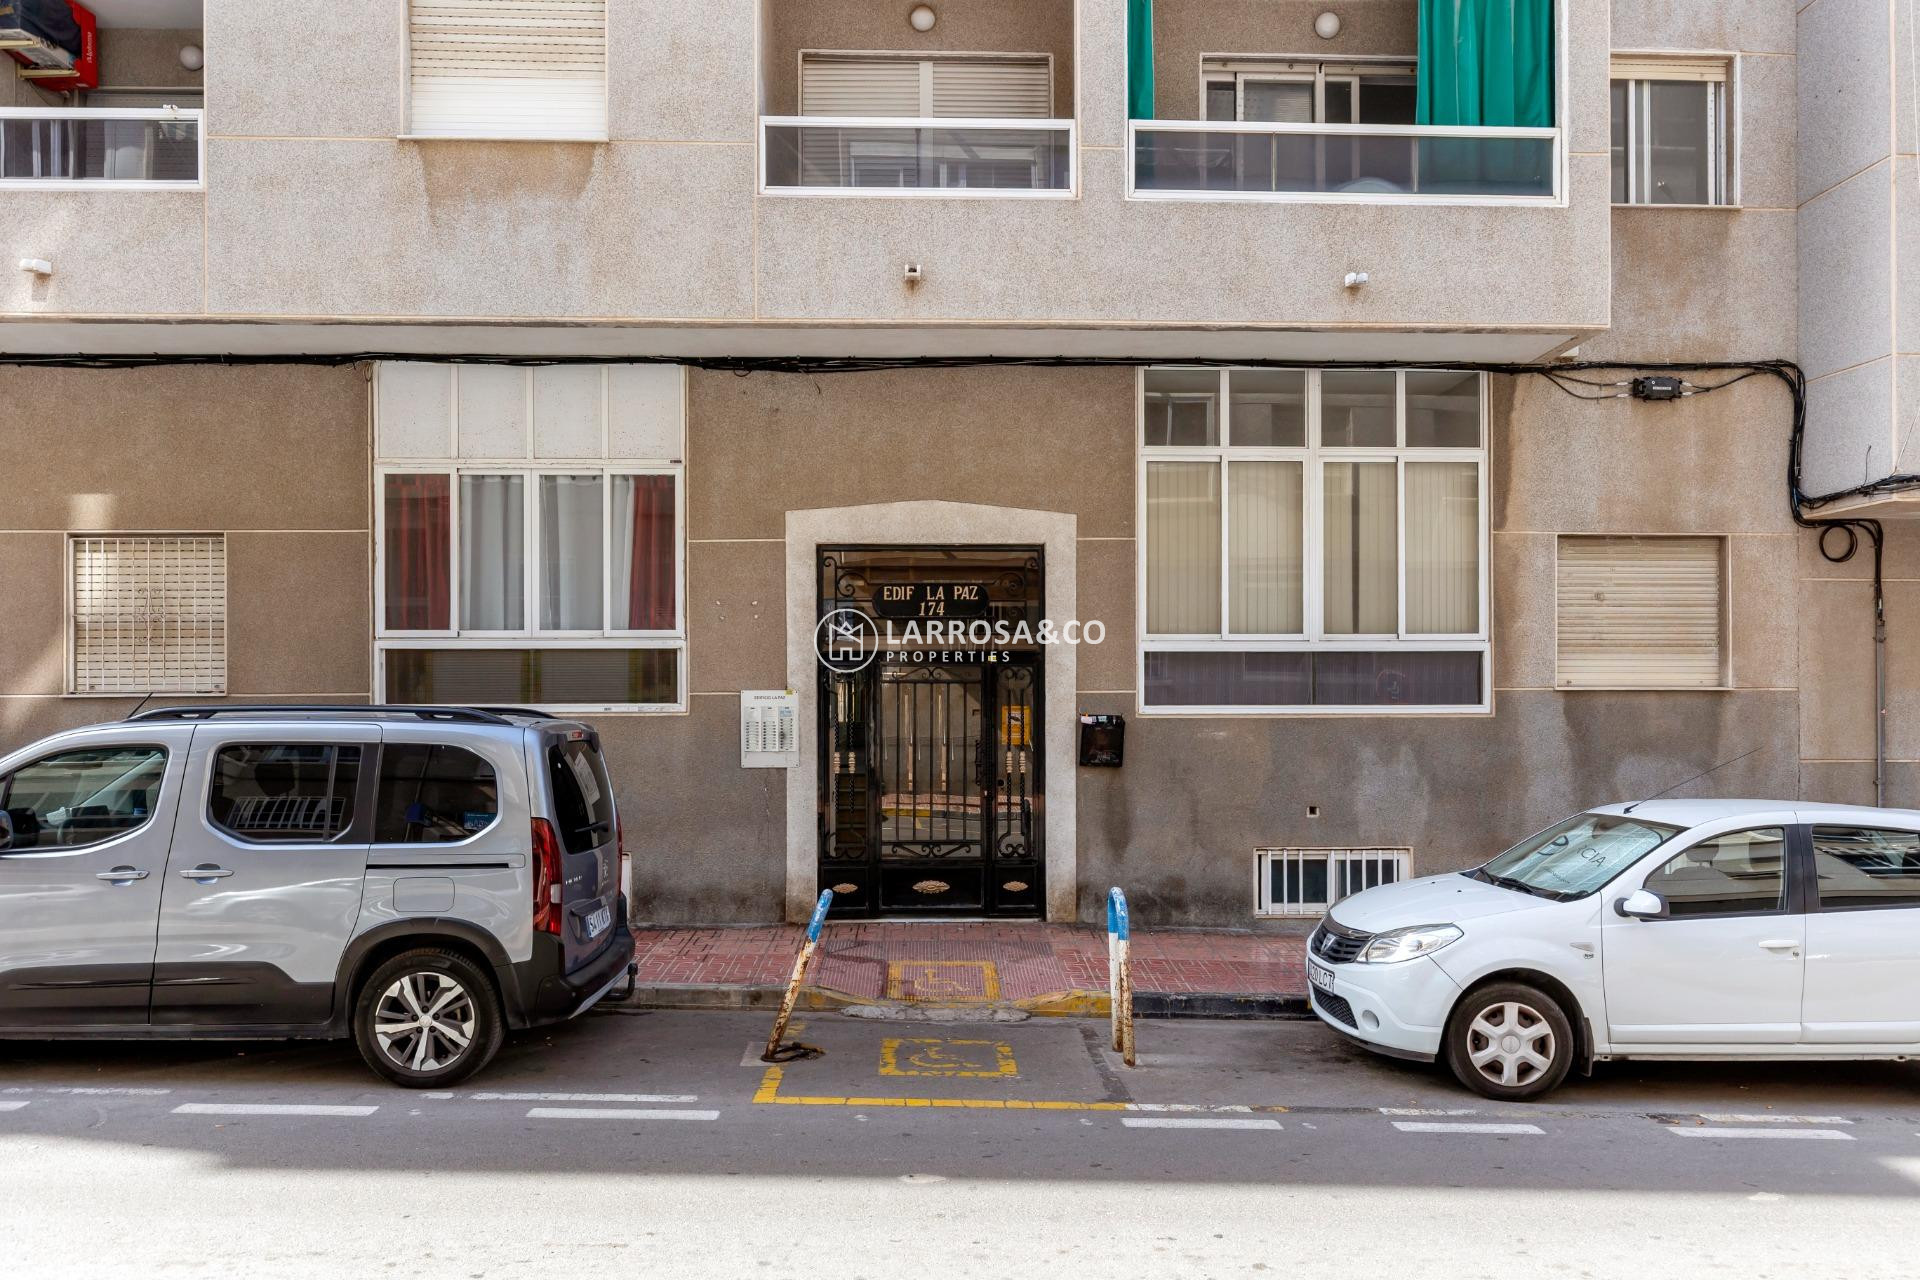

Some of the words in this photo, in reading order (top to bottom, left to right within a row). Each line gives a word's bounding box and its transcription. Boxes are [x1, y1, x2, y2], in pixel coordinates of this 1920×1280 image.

[883, 586, 915, 601] EDIF
[926, 586, 945, 600] LA
[953, 585, 979, 600] PAZ
[919, 601, 945, 616] 174
